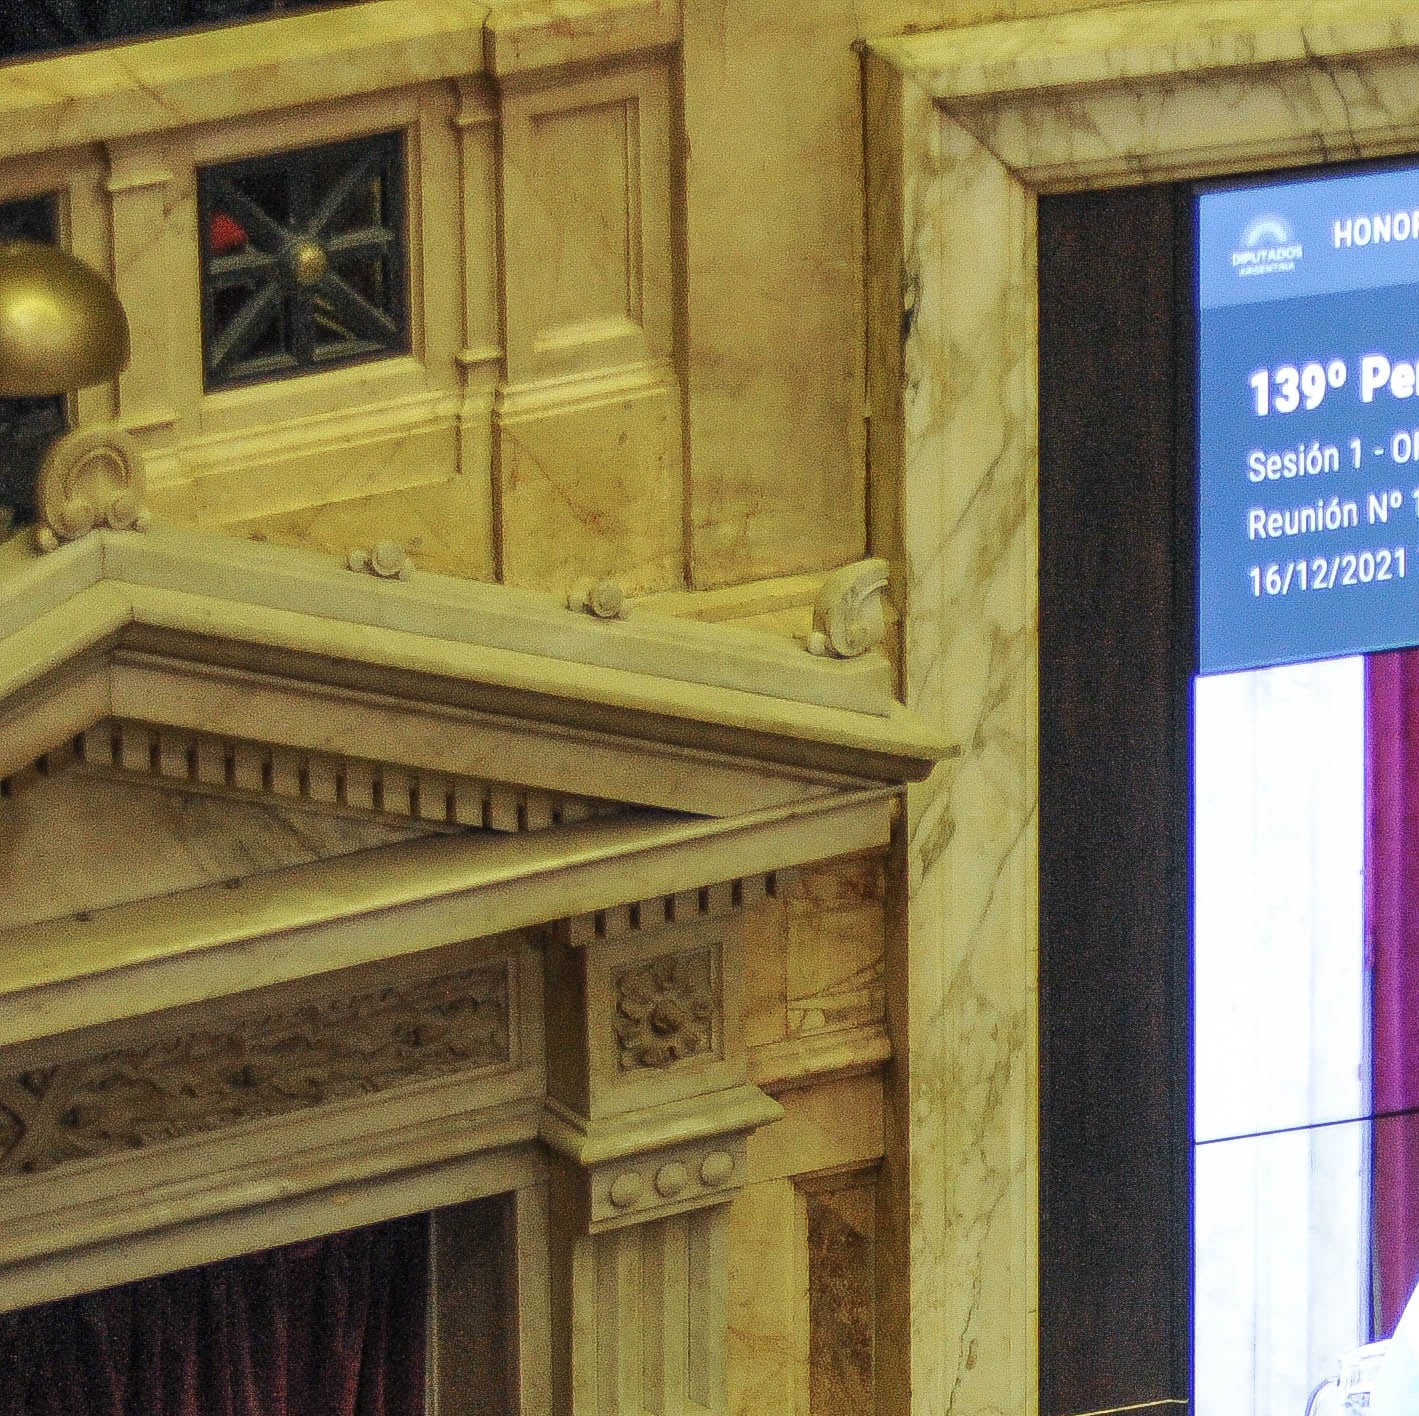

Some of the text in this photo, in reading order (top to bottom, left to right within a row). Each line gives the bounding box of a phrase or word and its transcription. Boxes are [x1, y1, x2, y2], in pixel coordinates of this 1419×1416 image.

[1232, 244, 1304, 267] DIPUTADOS
[1248, 438, 1339, 483] Sesión
[1349, 438, 1362, 469] 1
[1374, 447, 1385, 456] -
[1248, 497, 1358, 540] Reunión
[1249, 547, 1407, 597] 16/12/2021
